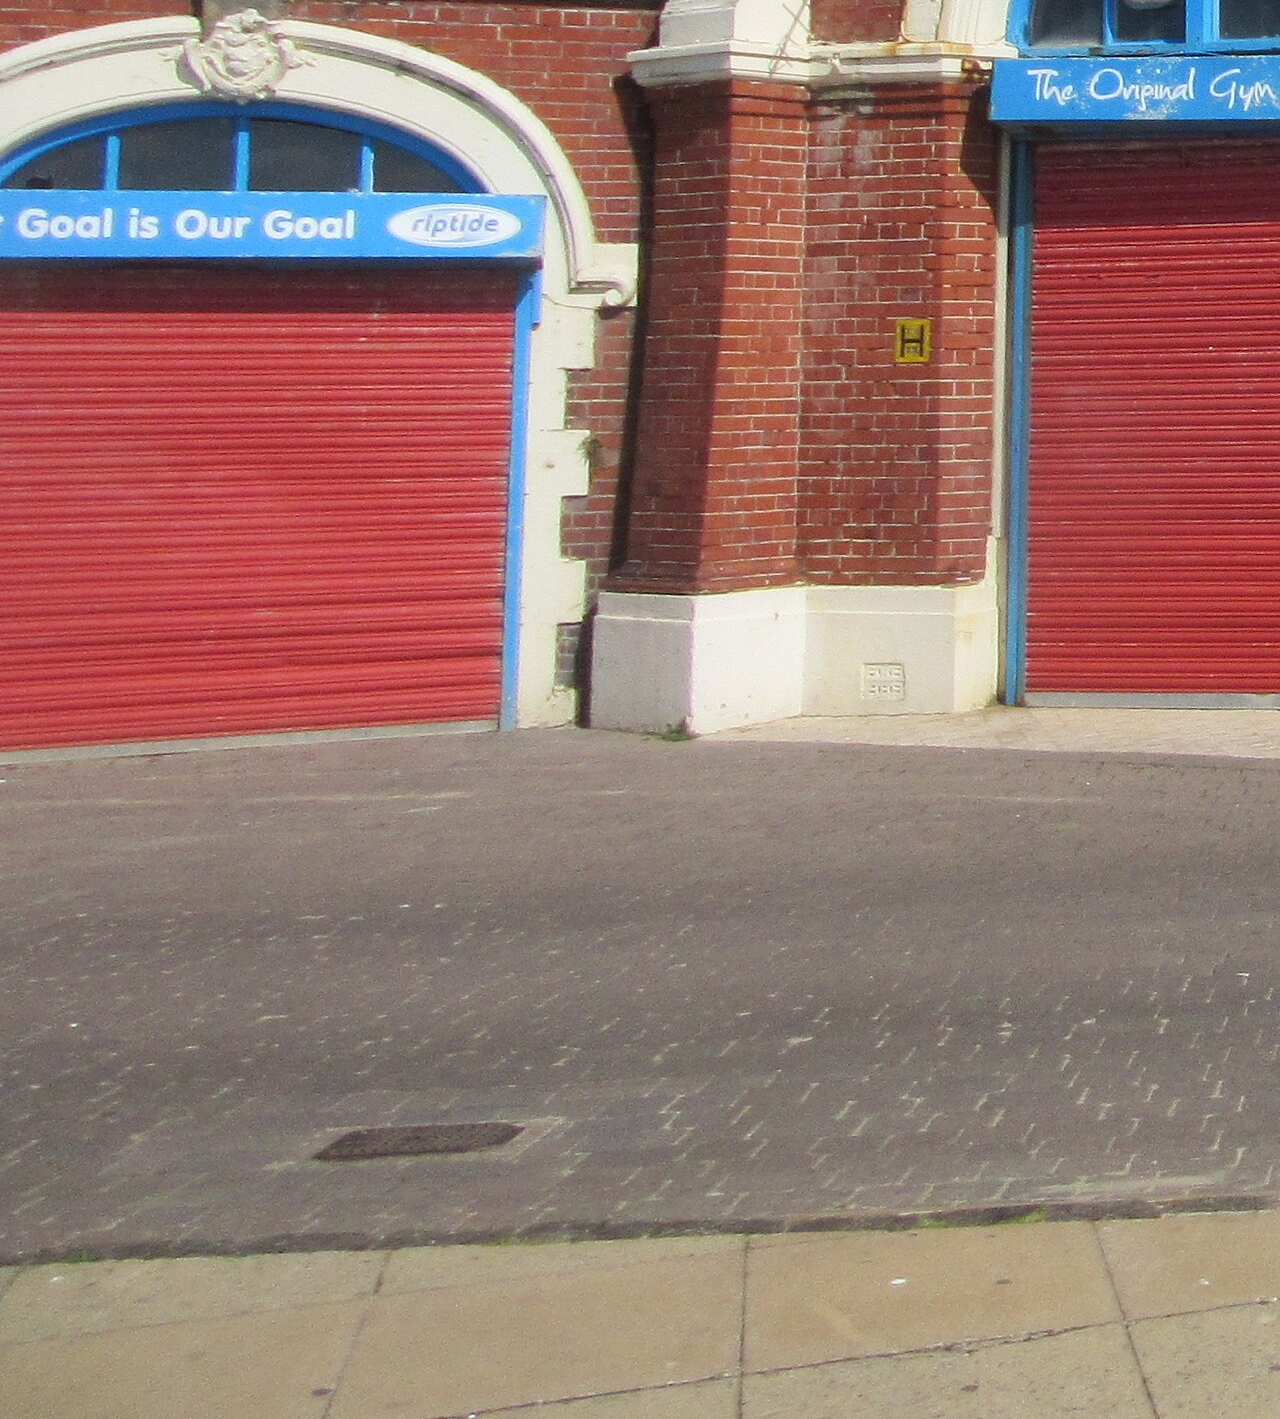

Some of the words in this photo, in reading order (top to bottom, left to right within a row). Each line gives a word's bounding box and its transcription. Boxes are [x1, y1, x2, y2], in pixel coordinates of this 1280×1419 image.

[1026, 69, 1078, 103] The
[1089, 67, 1197, 110] Original
[1210, 68, 1279, 110] Gym
[17, 207, 115, 240] Goal
[128, 207, 160, 240] is
[175, 208, 251, 240] Our
[262, 209, 356, 241] Goal
[410, 213, 499, 239] riptide
[901, 324, 923, 358] H
